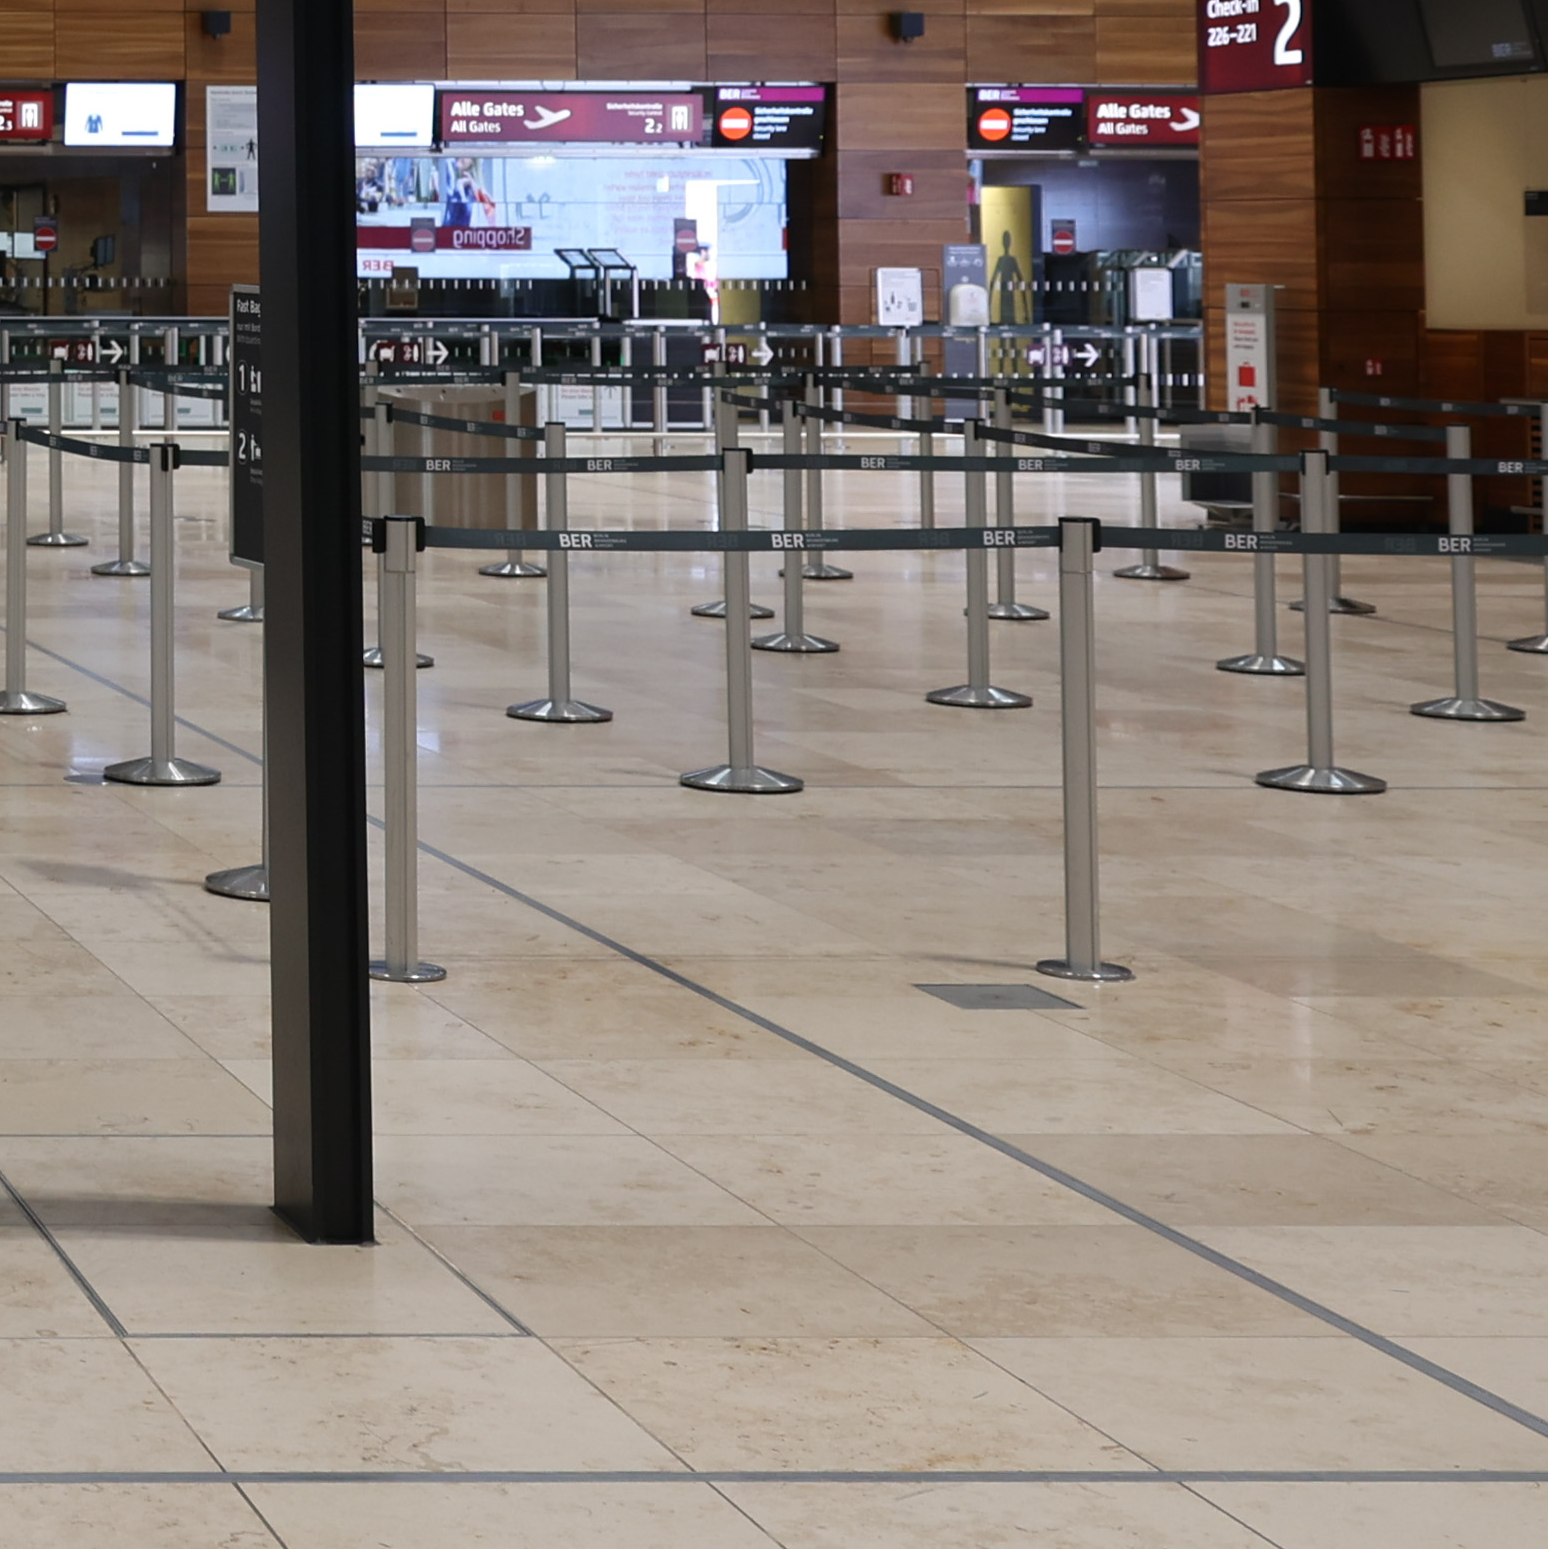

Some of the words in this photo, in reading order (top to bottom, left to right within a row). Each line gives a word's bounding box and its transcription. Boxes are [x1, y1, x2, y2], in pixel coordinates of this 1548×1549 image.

[451, 101, 481, 116] Alle
[483, 102, 524, 117] Gates
[451, 120, 466, 133] All
[469, 120, 501, 133] Gates
[236, 299, 249, 313] Fast
[239, 364, 245, 391] 1
[238, 432, 246, 460] 2
[861, 458, 885, 468] BER
[559, 534, 592, 547] BER
[1225, 534, 1257, 549] BER
